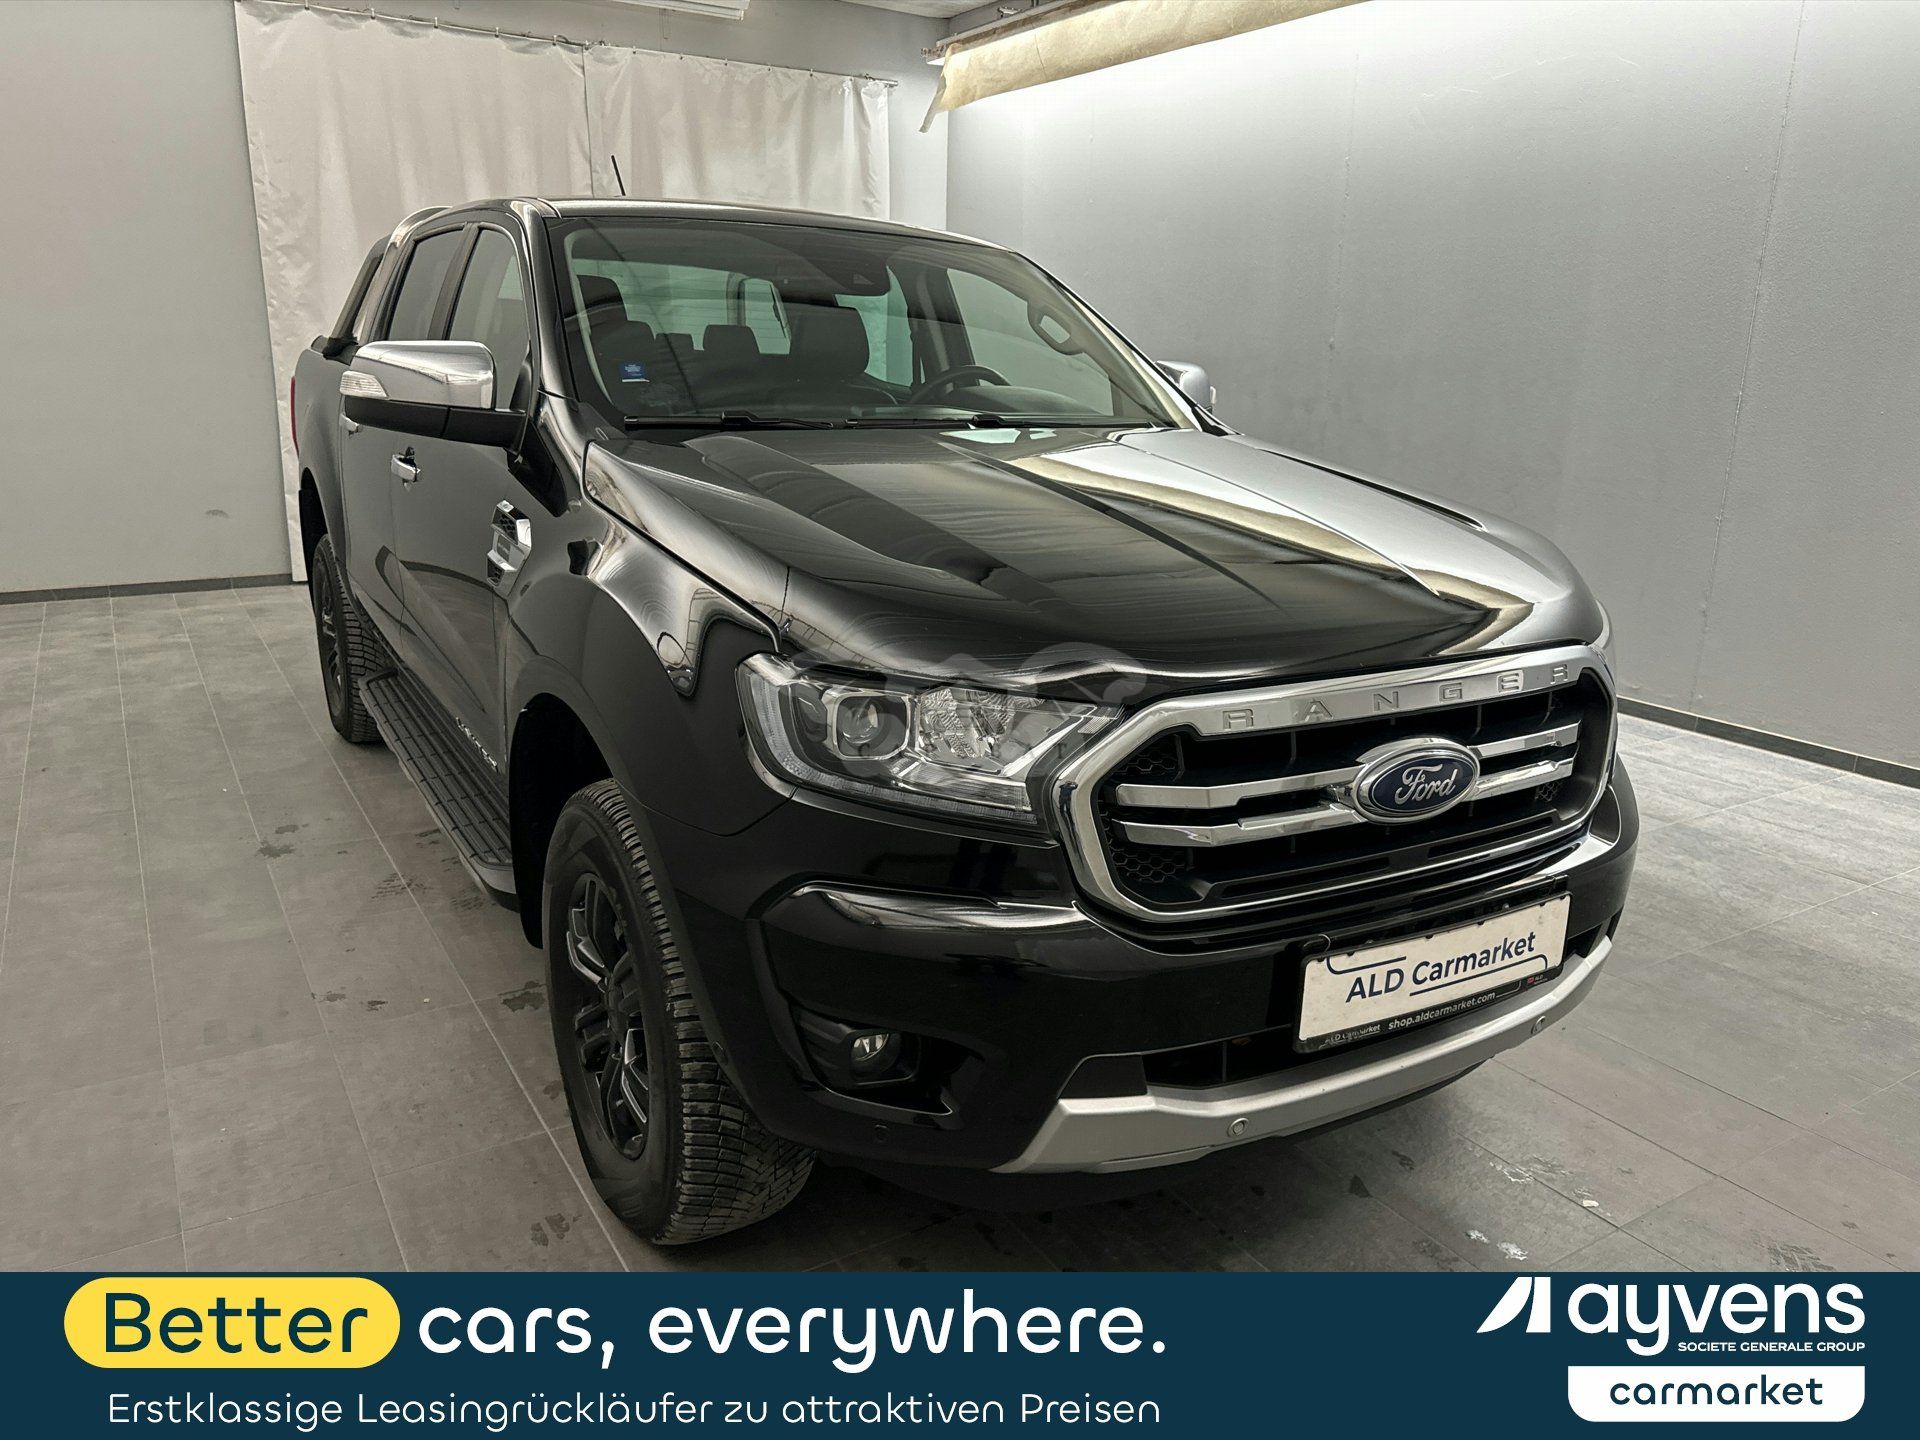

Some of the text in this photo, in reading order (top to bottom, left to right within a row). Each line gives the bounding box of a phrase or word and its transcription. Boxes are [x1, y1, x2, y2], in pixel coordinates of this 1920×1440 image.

[1222, 663, 1569, 730] RANGER
[1394, 763, 1457, 805] Ford
[1345, 931, 1536, 1003] ALD Carmarket
[1388, 991, 1496, 1031] shop.aldcarmarket.com
